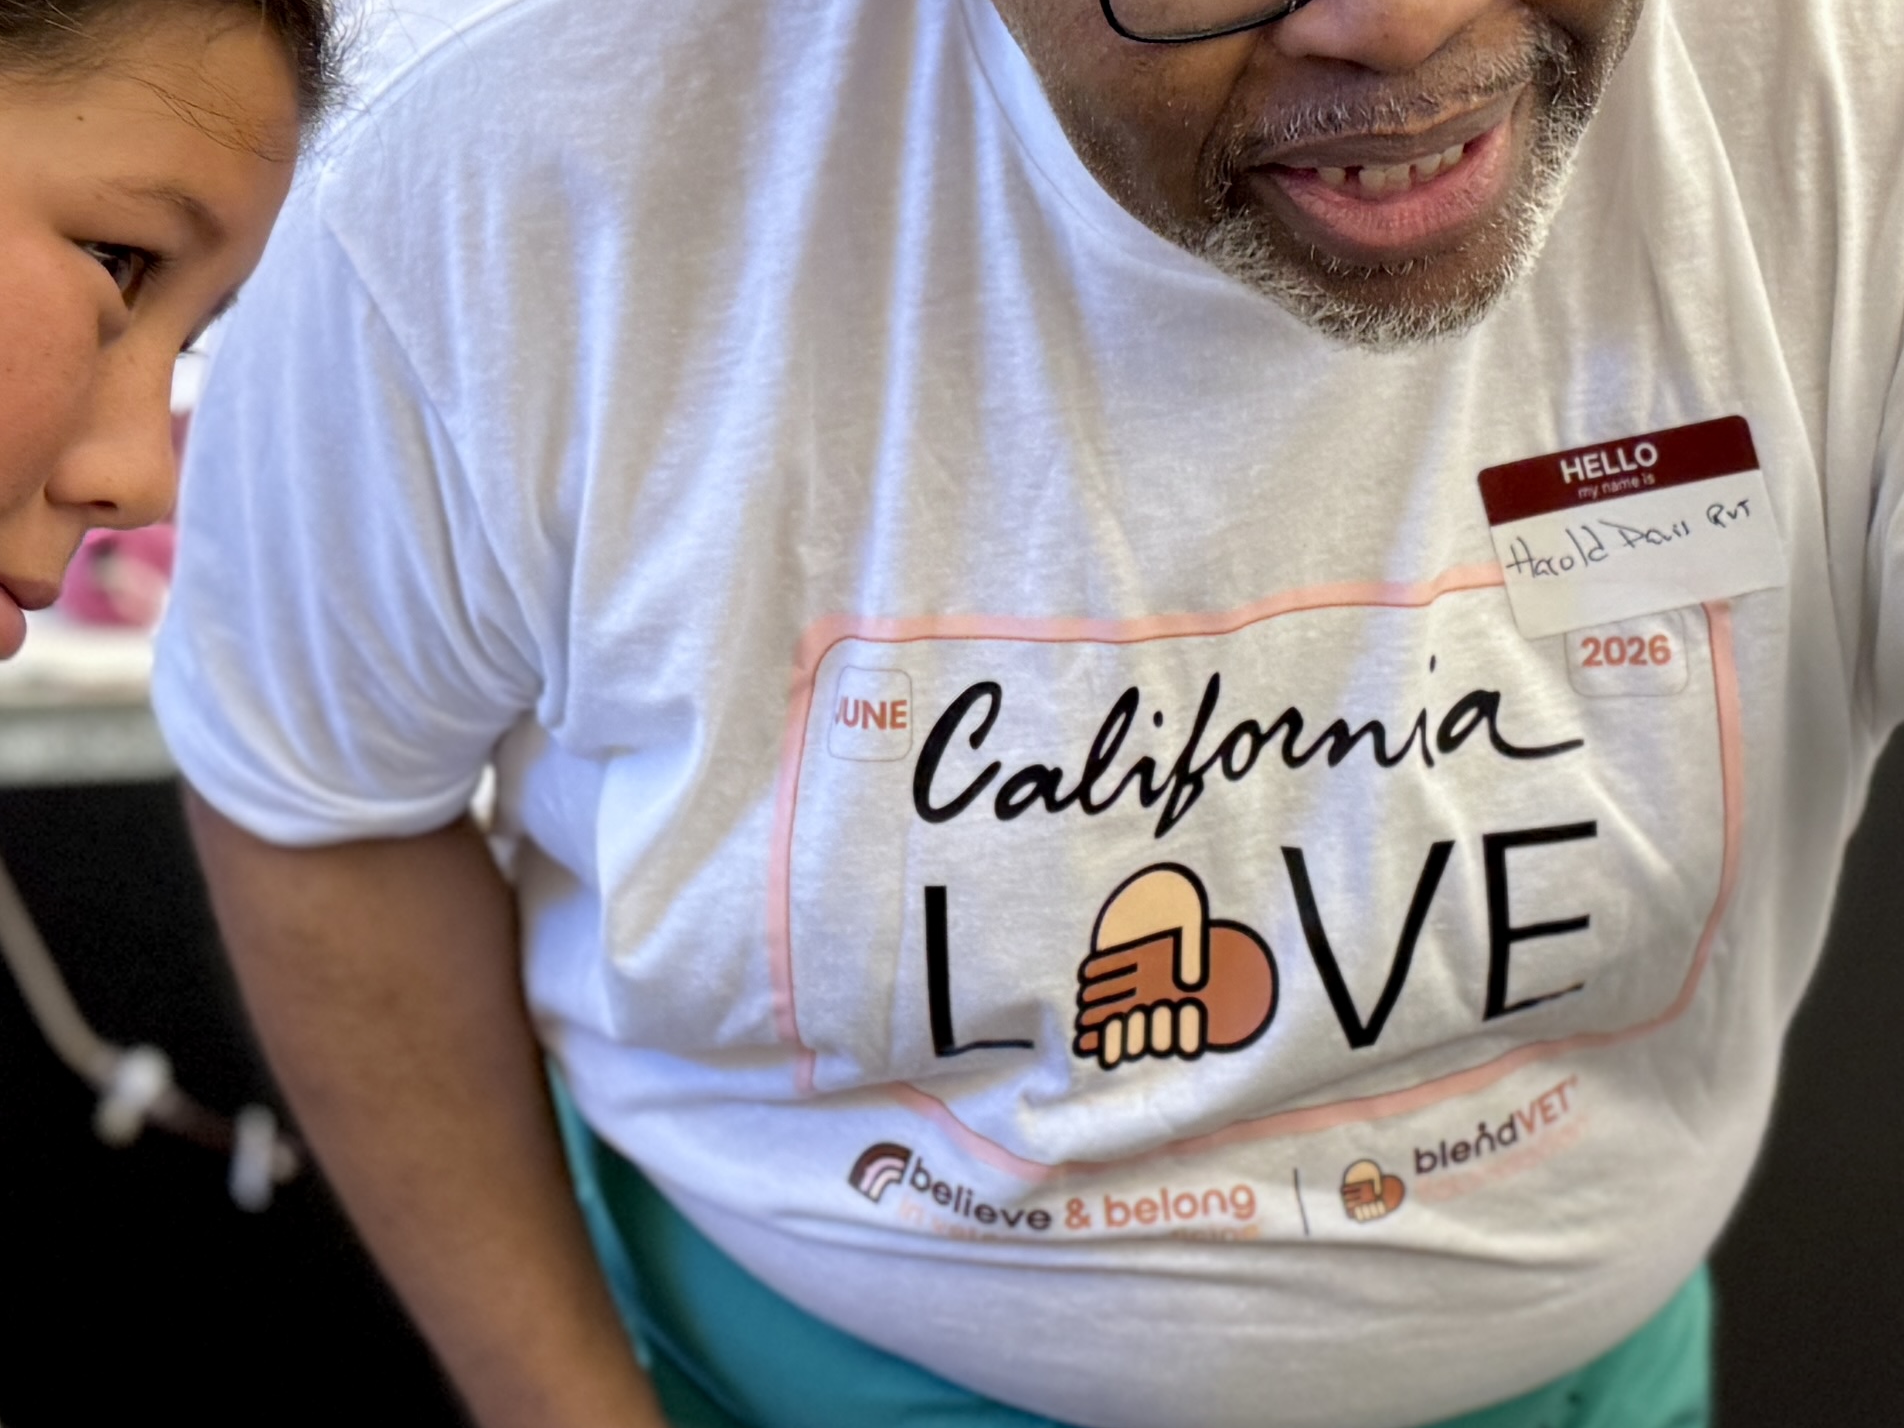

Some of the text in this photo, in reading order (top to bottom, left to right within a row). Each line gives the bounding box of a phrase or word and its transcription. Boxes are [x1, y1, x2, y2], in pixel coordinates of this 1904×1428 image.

[1560, 442, 1658, 484] HELLO
[1577, 473, 1656, 500] my name is
[1581, 634, 1672, 667] 2026
[913, 655, 1584, 839] California
[909, 1157, 1052, 1230] believe
[1064, 1197, 1091, 1230] &
[1104, 1183, 1257, 1229] belong
